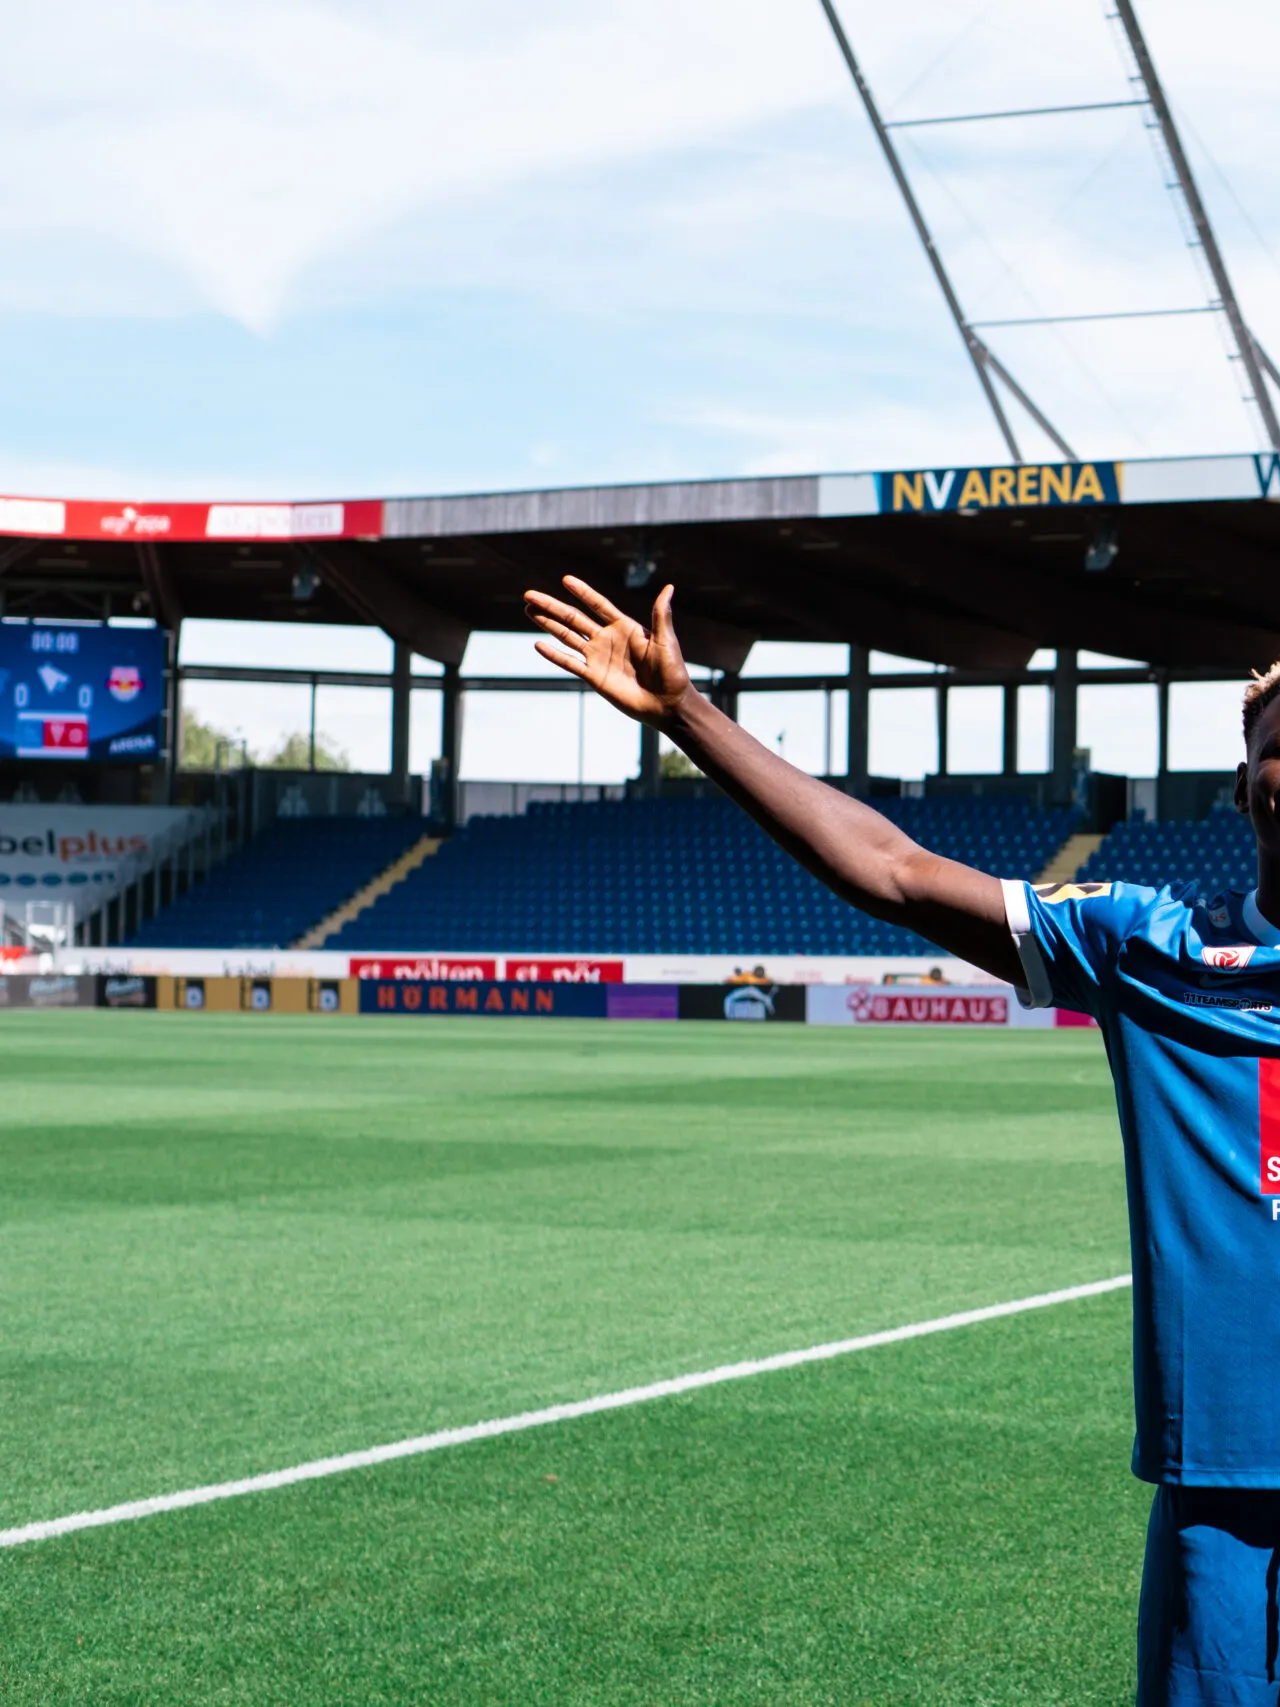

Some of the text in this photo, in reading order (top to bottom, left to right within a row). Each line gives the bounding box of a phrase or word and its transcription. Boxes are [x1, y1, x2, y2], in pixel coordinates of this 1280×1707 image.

[893, 463, 1105, 511] NV ARENA
[378, 985, 553, 1012] HÖRMANN
[873, 999, 1006, 1021] BAUHAUS
